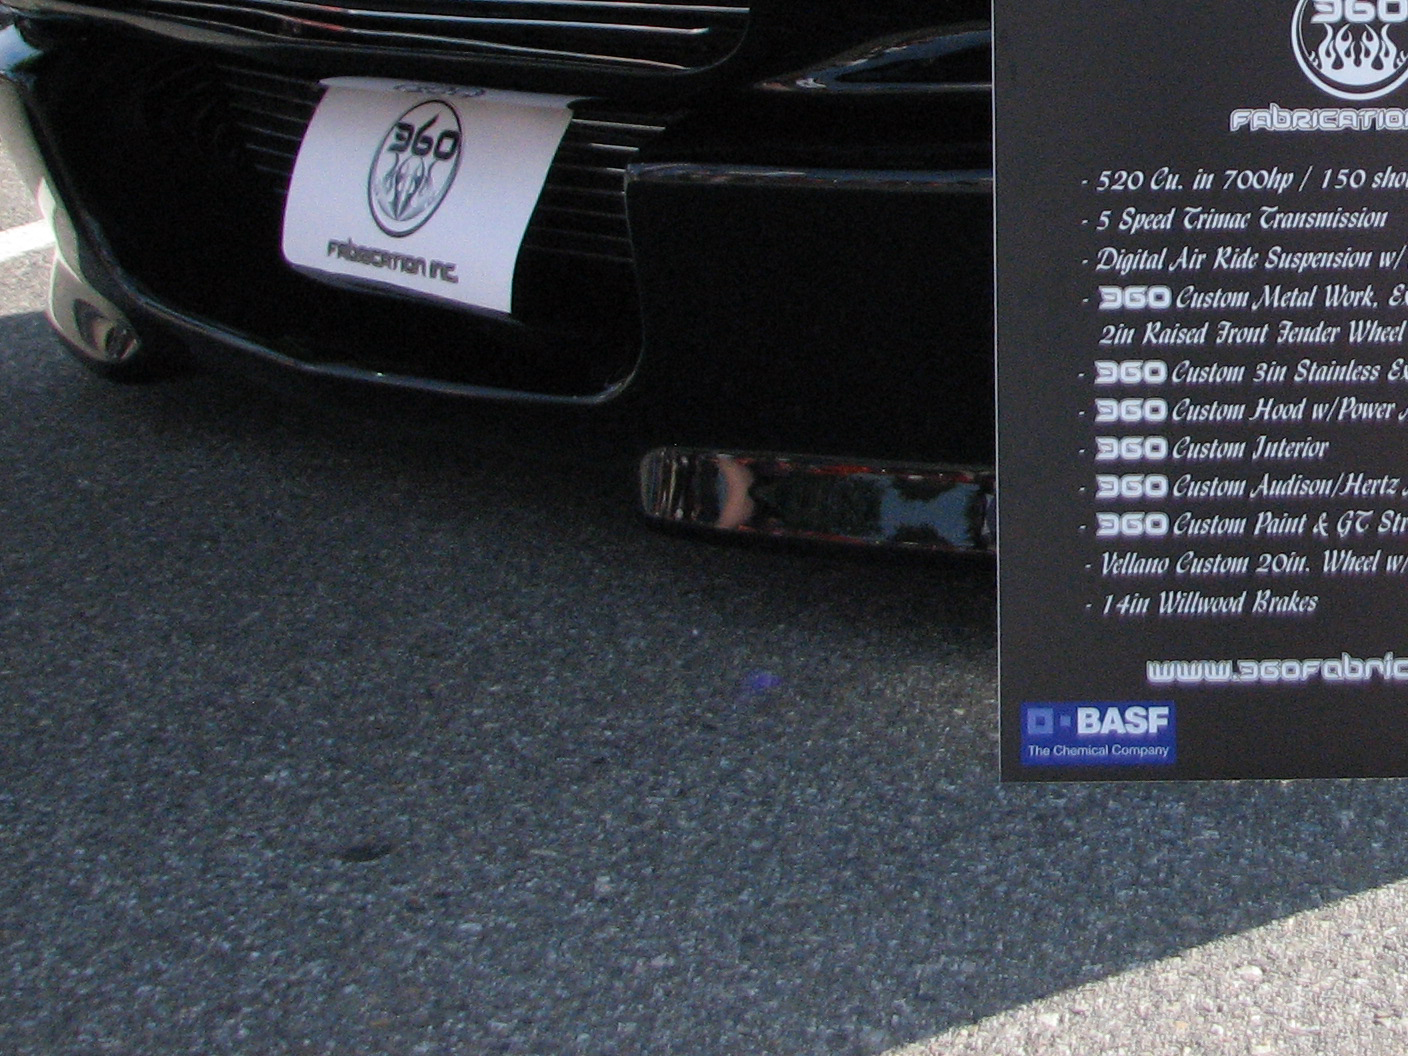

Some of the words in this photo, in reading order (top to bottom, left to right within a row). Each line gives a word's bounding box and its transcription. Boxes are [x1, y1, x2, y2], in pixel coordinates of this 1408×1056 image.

[387, 111, 462, 161] 360
[1096, 170, 1144, 190] 520
[1150, 167, 1183, 190] Cu.
[1192, 169, 1214, 190] in
[1222, 166, 1294, 194] 700hp
[1322, 169, 1366, 189] 150
[1096, 210, 1112, 230] 5
[1118, 207, 1176, 234] Speed
[1183, 206, 1251, 229] Trimac
[1259, 205, 1388, 229] Transmission
[1095, 246, 1167, 275] Digital
[1168, 246, 1206, 271] Air
[1212, 246, 1259, 269] Ride
[1265, 246, 1373, 273] Suspension
[1379, 245, 1407, 269] w/
[1098, 284, 1172, 310] 360
[1175, 287, 1250, 309] Custom
[1251, 284, 1316, 311] Metal
[1099, 324, 1135, 345] 2in
[1142, 321, 1209, 344] Raised
[1216, 320, 1269, 344] Front
[1277, 320, 1341, 343] Fender
[1348, 319, 1408, 343] Wheel
[1094, 360, 1167, 385] 360
[1171, 360, 1245, 383] Custom
[1253, 360, 1287, 382] 3in
[1294, 358, 1381, 382] Stainless
[1094, 398, 1168, 422] 360
[1172, 398, 1246, 421] Custom
[1249, 397, 1306, 421] Hood
[1312, 396, 1396, 422] w/Power
[1095, 436, 1168, 461] 360
[1172, 436, 1246, 460] Custom
[1250, 436, 1330, 460] Interior
[1095, 474, 1168, 499] 360
[1173, 474, 1246, 498] Custom
[1250, 472, 1400, 498] Audison/Hertz
[1095, 512, 1169, 536] 360
[1173, 512, 1246, 536] Custom
[1253, 511, 1306, 535] Paint
[1312, 513, 1328, 536] &
[1337, 510, 1374, 536] GT
[1101, 552, 1168, 574] Vellano
[1175, 551, 1250, 574] Custom
[1255, 552, 1310, 572] 20in.
[1323, 550, 1382, 572] Wheel
[1103, 593, 1150, 614] 14in
[1159, 591, 1246, 614] Willwood
[1252, 589, 1318, 612] Brakes
[1077, 706, 1169, 734] BASF
[1029, 744, 1050, 756] The
[1054, 743, 1109, 756] Chemical
[1112, 743, 1169, 758] Company
